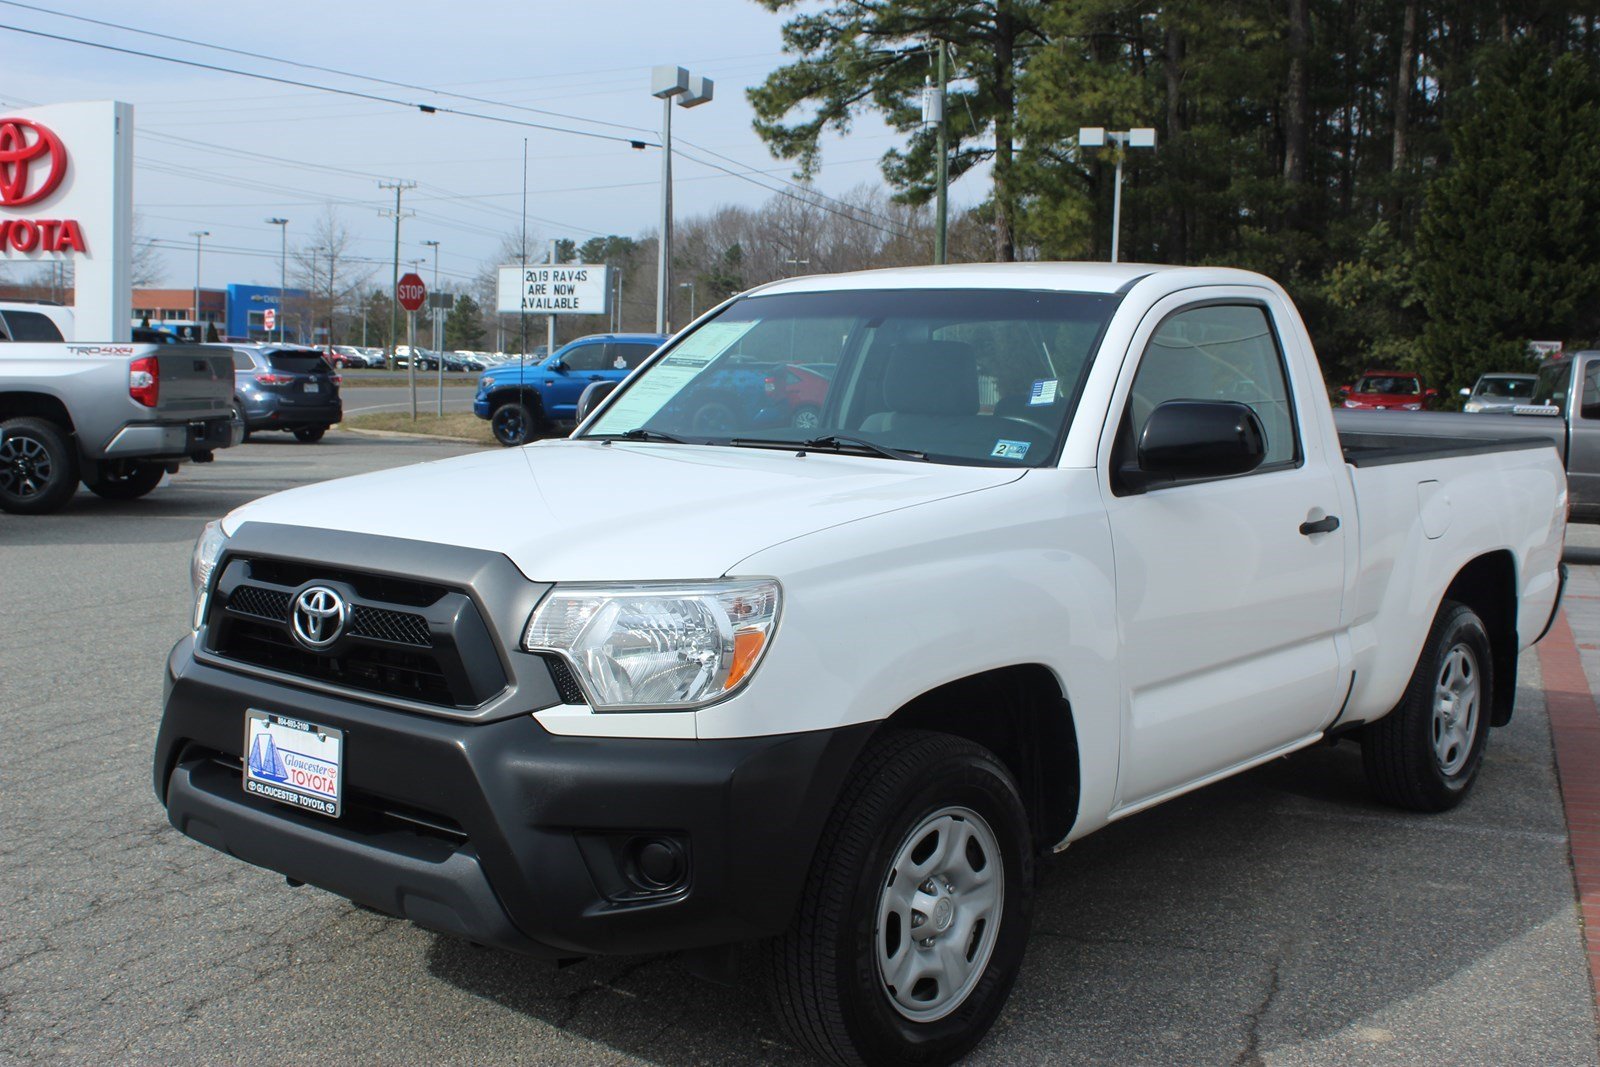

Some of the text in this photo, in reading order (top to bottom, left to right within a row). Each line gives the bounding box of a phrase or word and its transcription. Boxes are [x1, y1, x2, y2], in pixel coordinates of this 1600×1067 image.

[526, 270, 587, 282] 2019 RAV4S
[399, 284, 424, 300] STOP
[528, 284, 575, 295] ARE NOW
[521, 298, 579, 308] AVAILABLE
[996, 444, 1006, 454] 2
[284, 753, 327, 776] Gloucester
[291, 769, 336, 794] TOYOTA
[256, 784, 326, 811] GLOUCESTER TOYOTA
